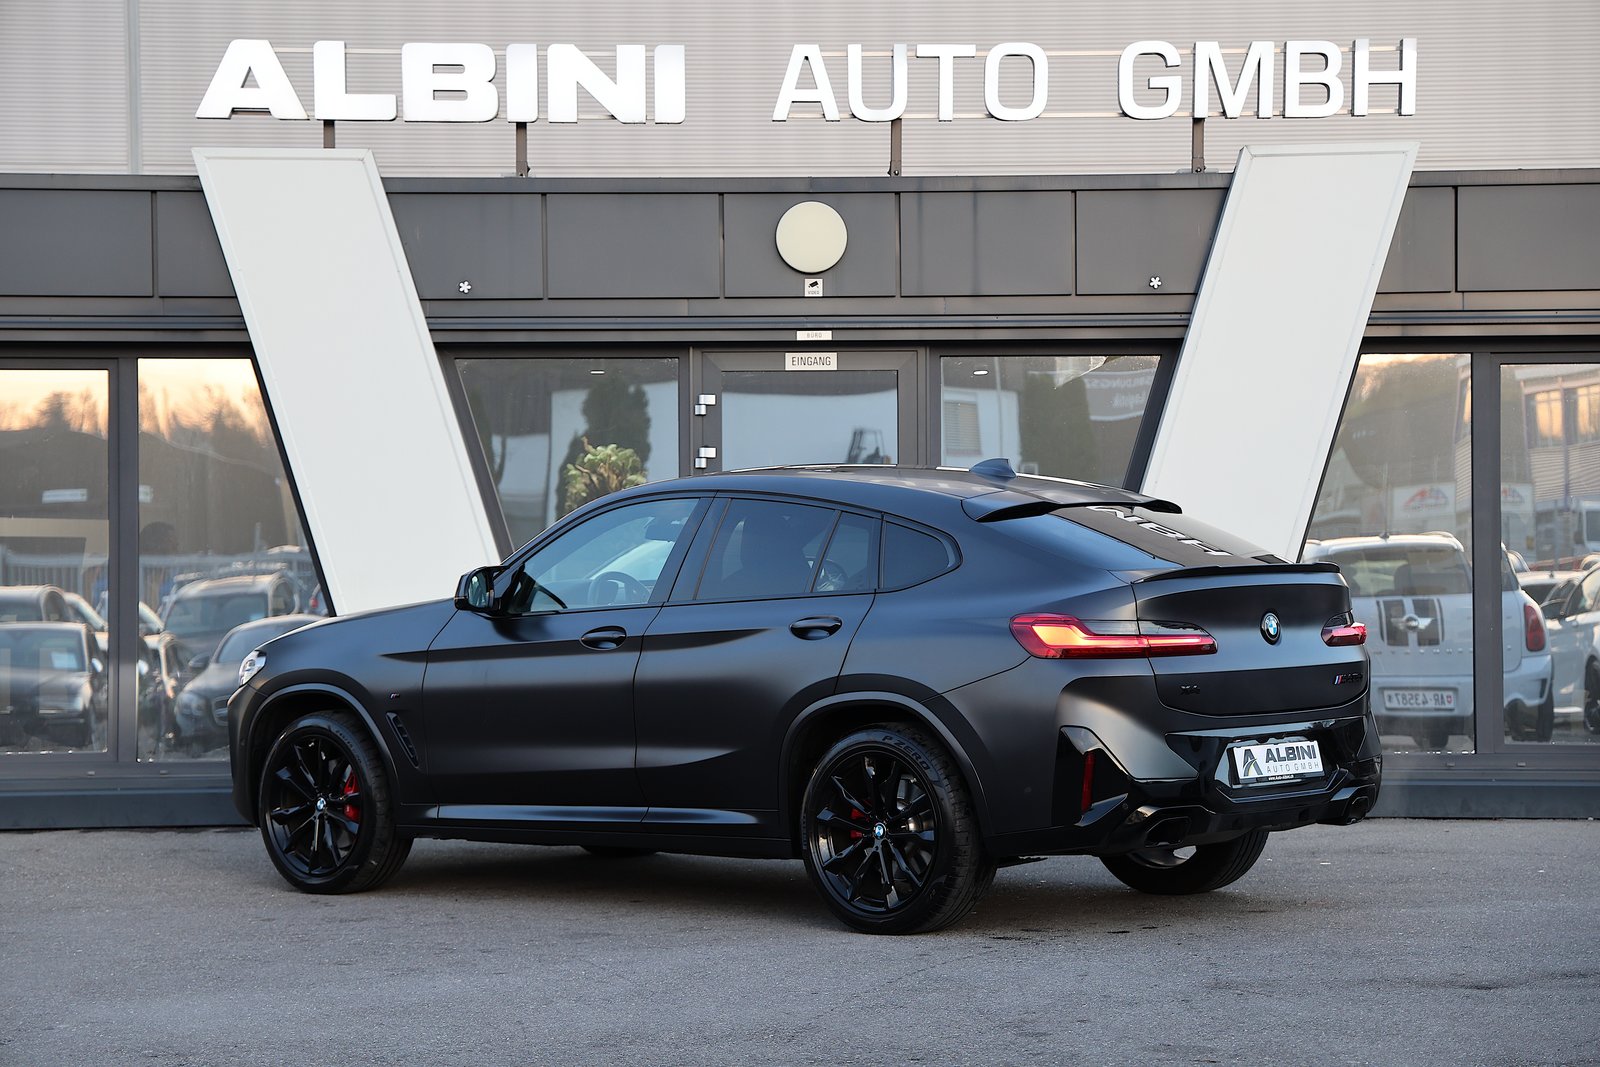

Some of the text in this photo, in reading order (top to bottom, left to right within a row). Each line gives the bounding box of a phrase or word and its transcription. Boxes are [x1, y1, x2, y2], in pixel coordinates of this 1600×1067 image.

[195, 38, 1418, 125] ALBINI AUTO GMBH
[791, 356, 832, 366] EINGANG
[893, 741, 931, 771] ZERO
[1265, 745, 1317, 763] ALBINI
[1266, 761, 1320, 773] AUTO GMBH
